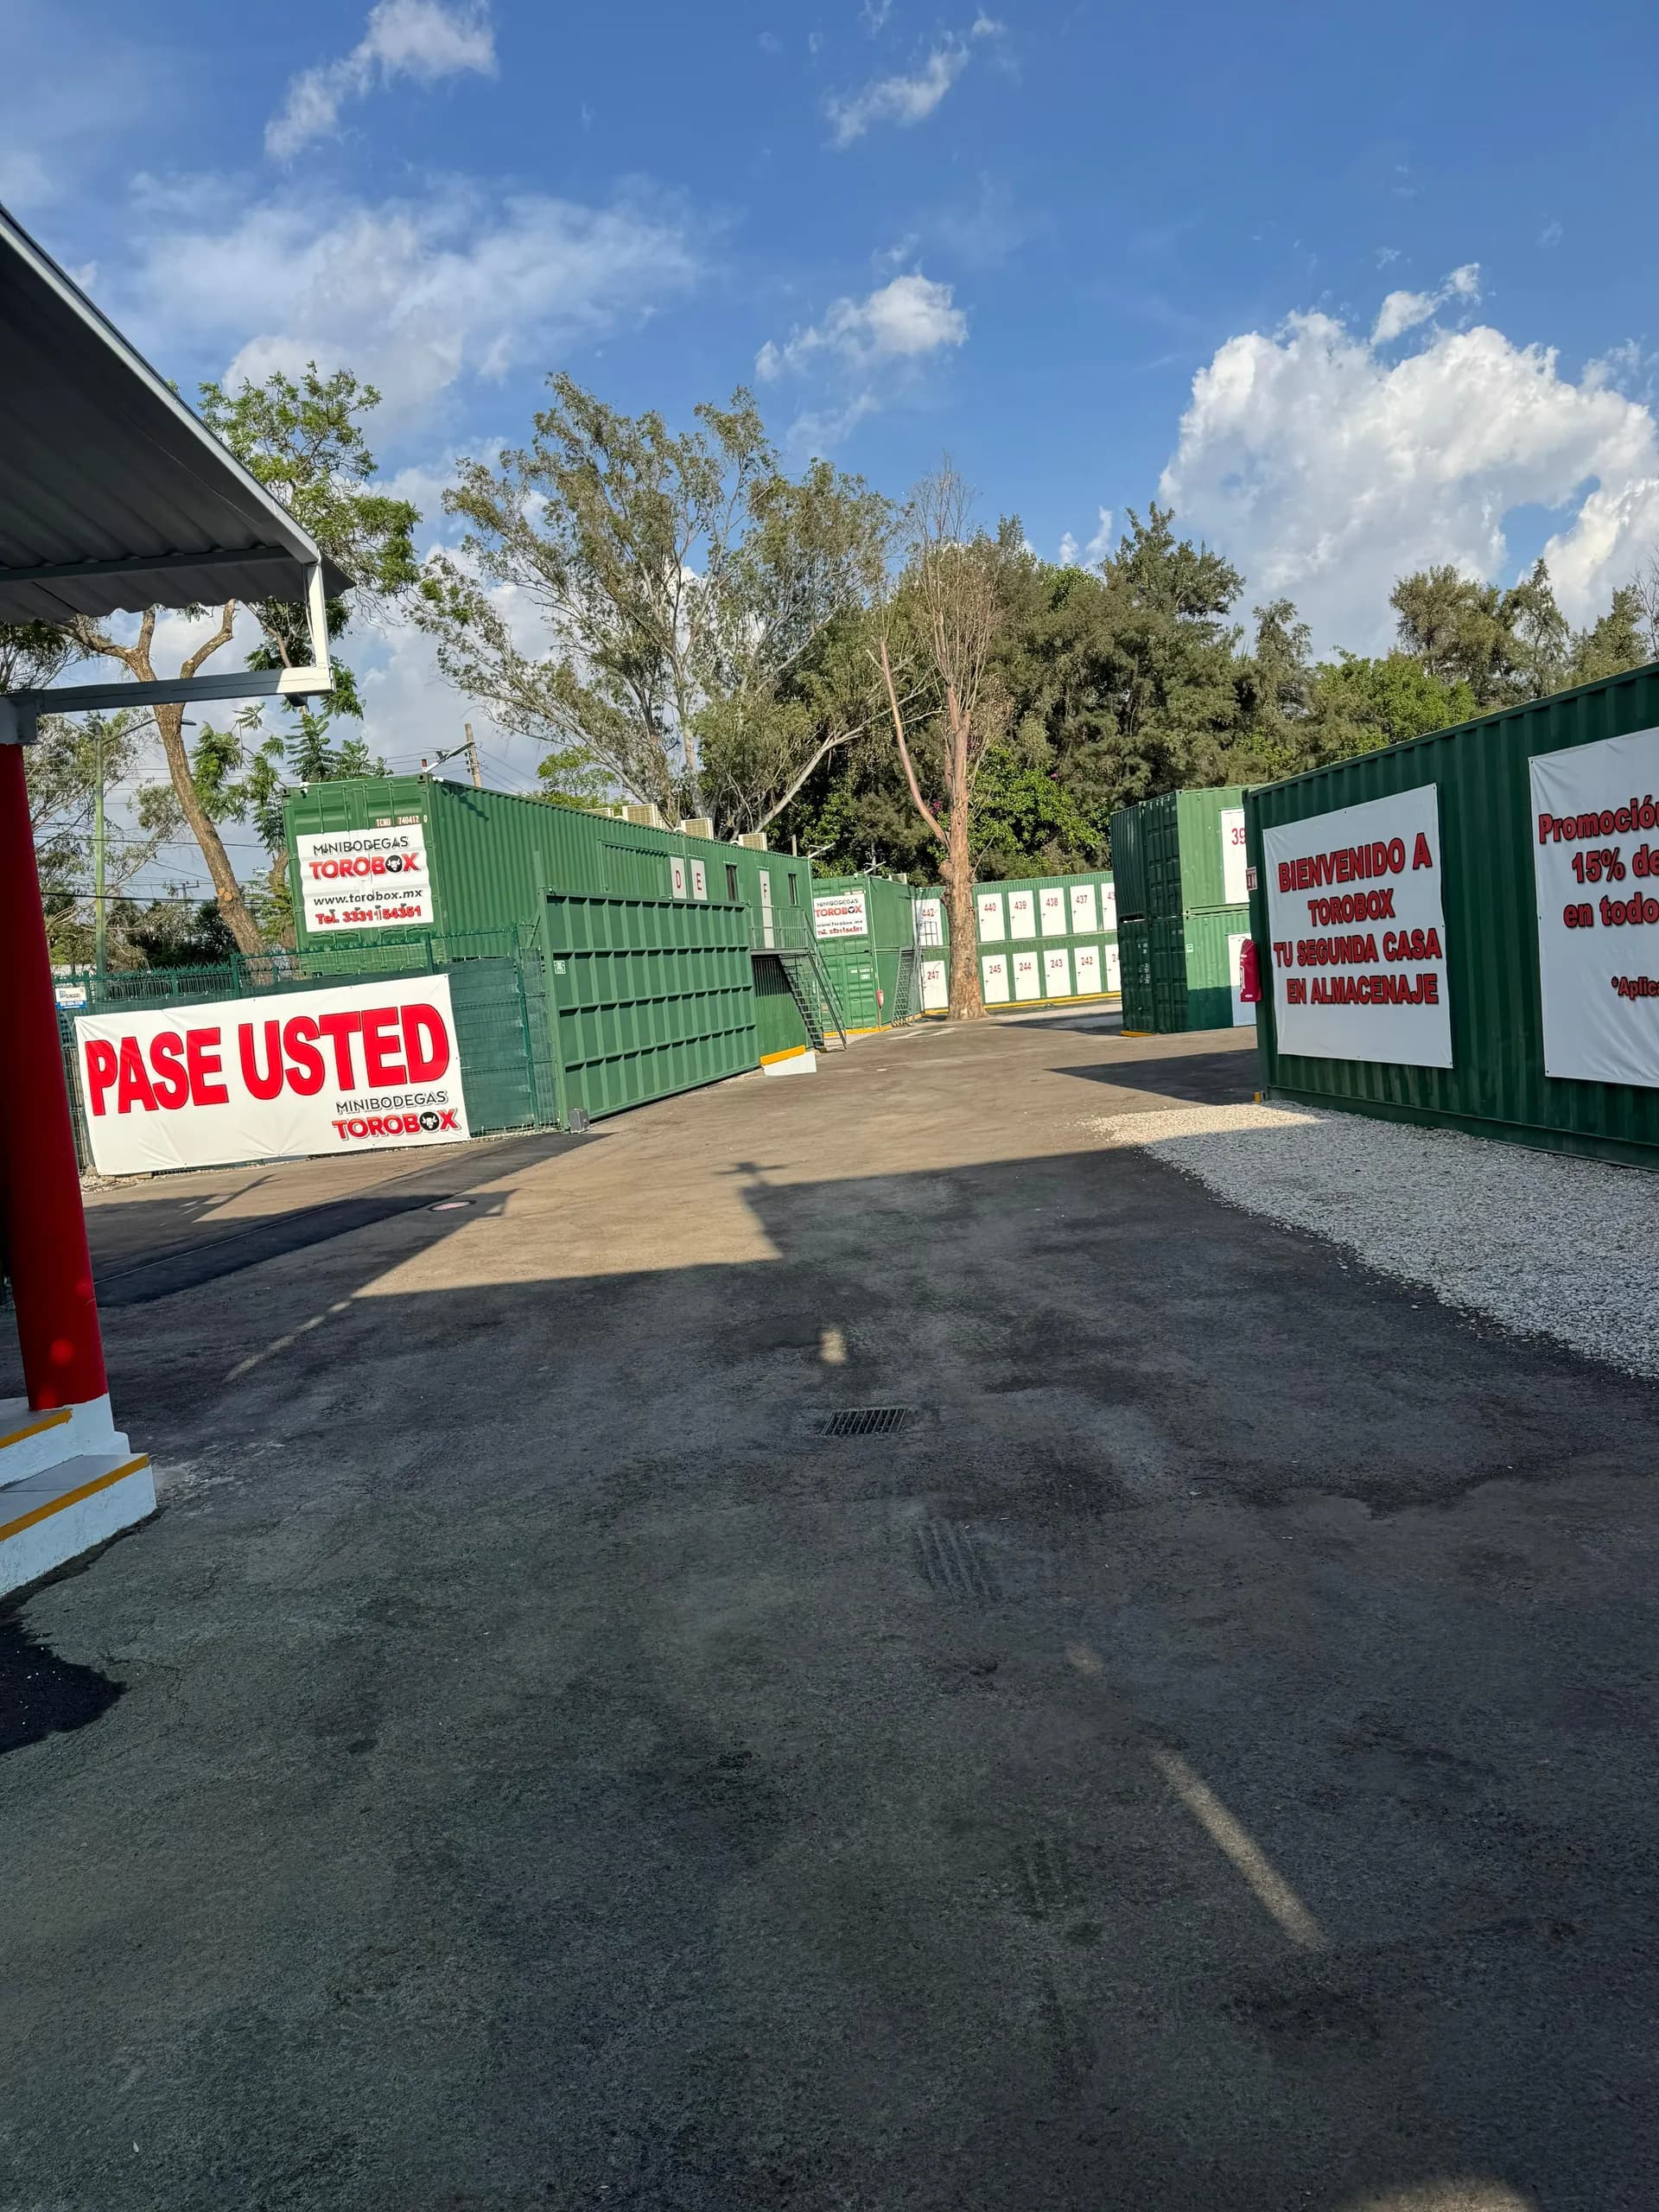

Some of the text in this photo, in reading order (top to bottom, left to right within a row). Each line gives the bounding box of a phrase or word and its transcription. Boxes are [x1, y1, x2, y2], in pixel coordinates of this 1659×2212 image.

[313, 836, 409, 855] MINIBODEGAS
[1231, 828, 1245, 845] 39
[309, 853, 420, 880] TOROBOX
[1278, 832, 1433, 893] BIENVENIDO A
[1572, 847, 1626, 883] 15%
[676, 870, 682, 889] D
[696, 873, 702, 891] E
[314, 889, 423, 906] www.torobox.mx
[1014, 900, 1027, 910] 439
[1046, 898, 1058, 906] 438
[1076, 894, 1088, 904] 437
[315, 906, 422, 925] Tel. 3331154351
[815, 905, 862, 918] TOROBOX
[922, 908, 934, 917] 442
[984, 903, 996, 912] 440
[1307, 888, 1395, 927] TOROBOX
[1563, 903, 1593, 928] en
[1274, 928, 1442, 968] TU SEGUNDA CASA
[989, 964, 1001, 974] 245
[1020, 962, 1032, 971] 244
[1051, 958, 1063, 969] 243
[1081, 957, 1093, 966] 242
[927, 971, 939, 980] 247
[1287, 974, 1439, 1004] EN ALMACENAJE
[1611, 976, 1659, 1000] Aplic
[85, 1003, 449, 1116] PASE USTED
[336, 1090, 448, 1114] MINIBODEGAS
[332, 1109, 460, 1140] TOROBOX
